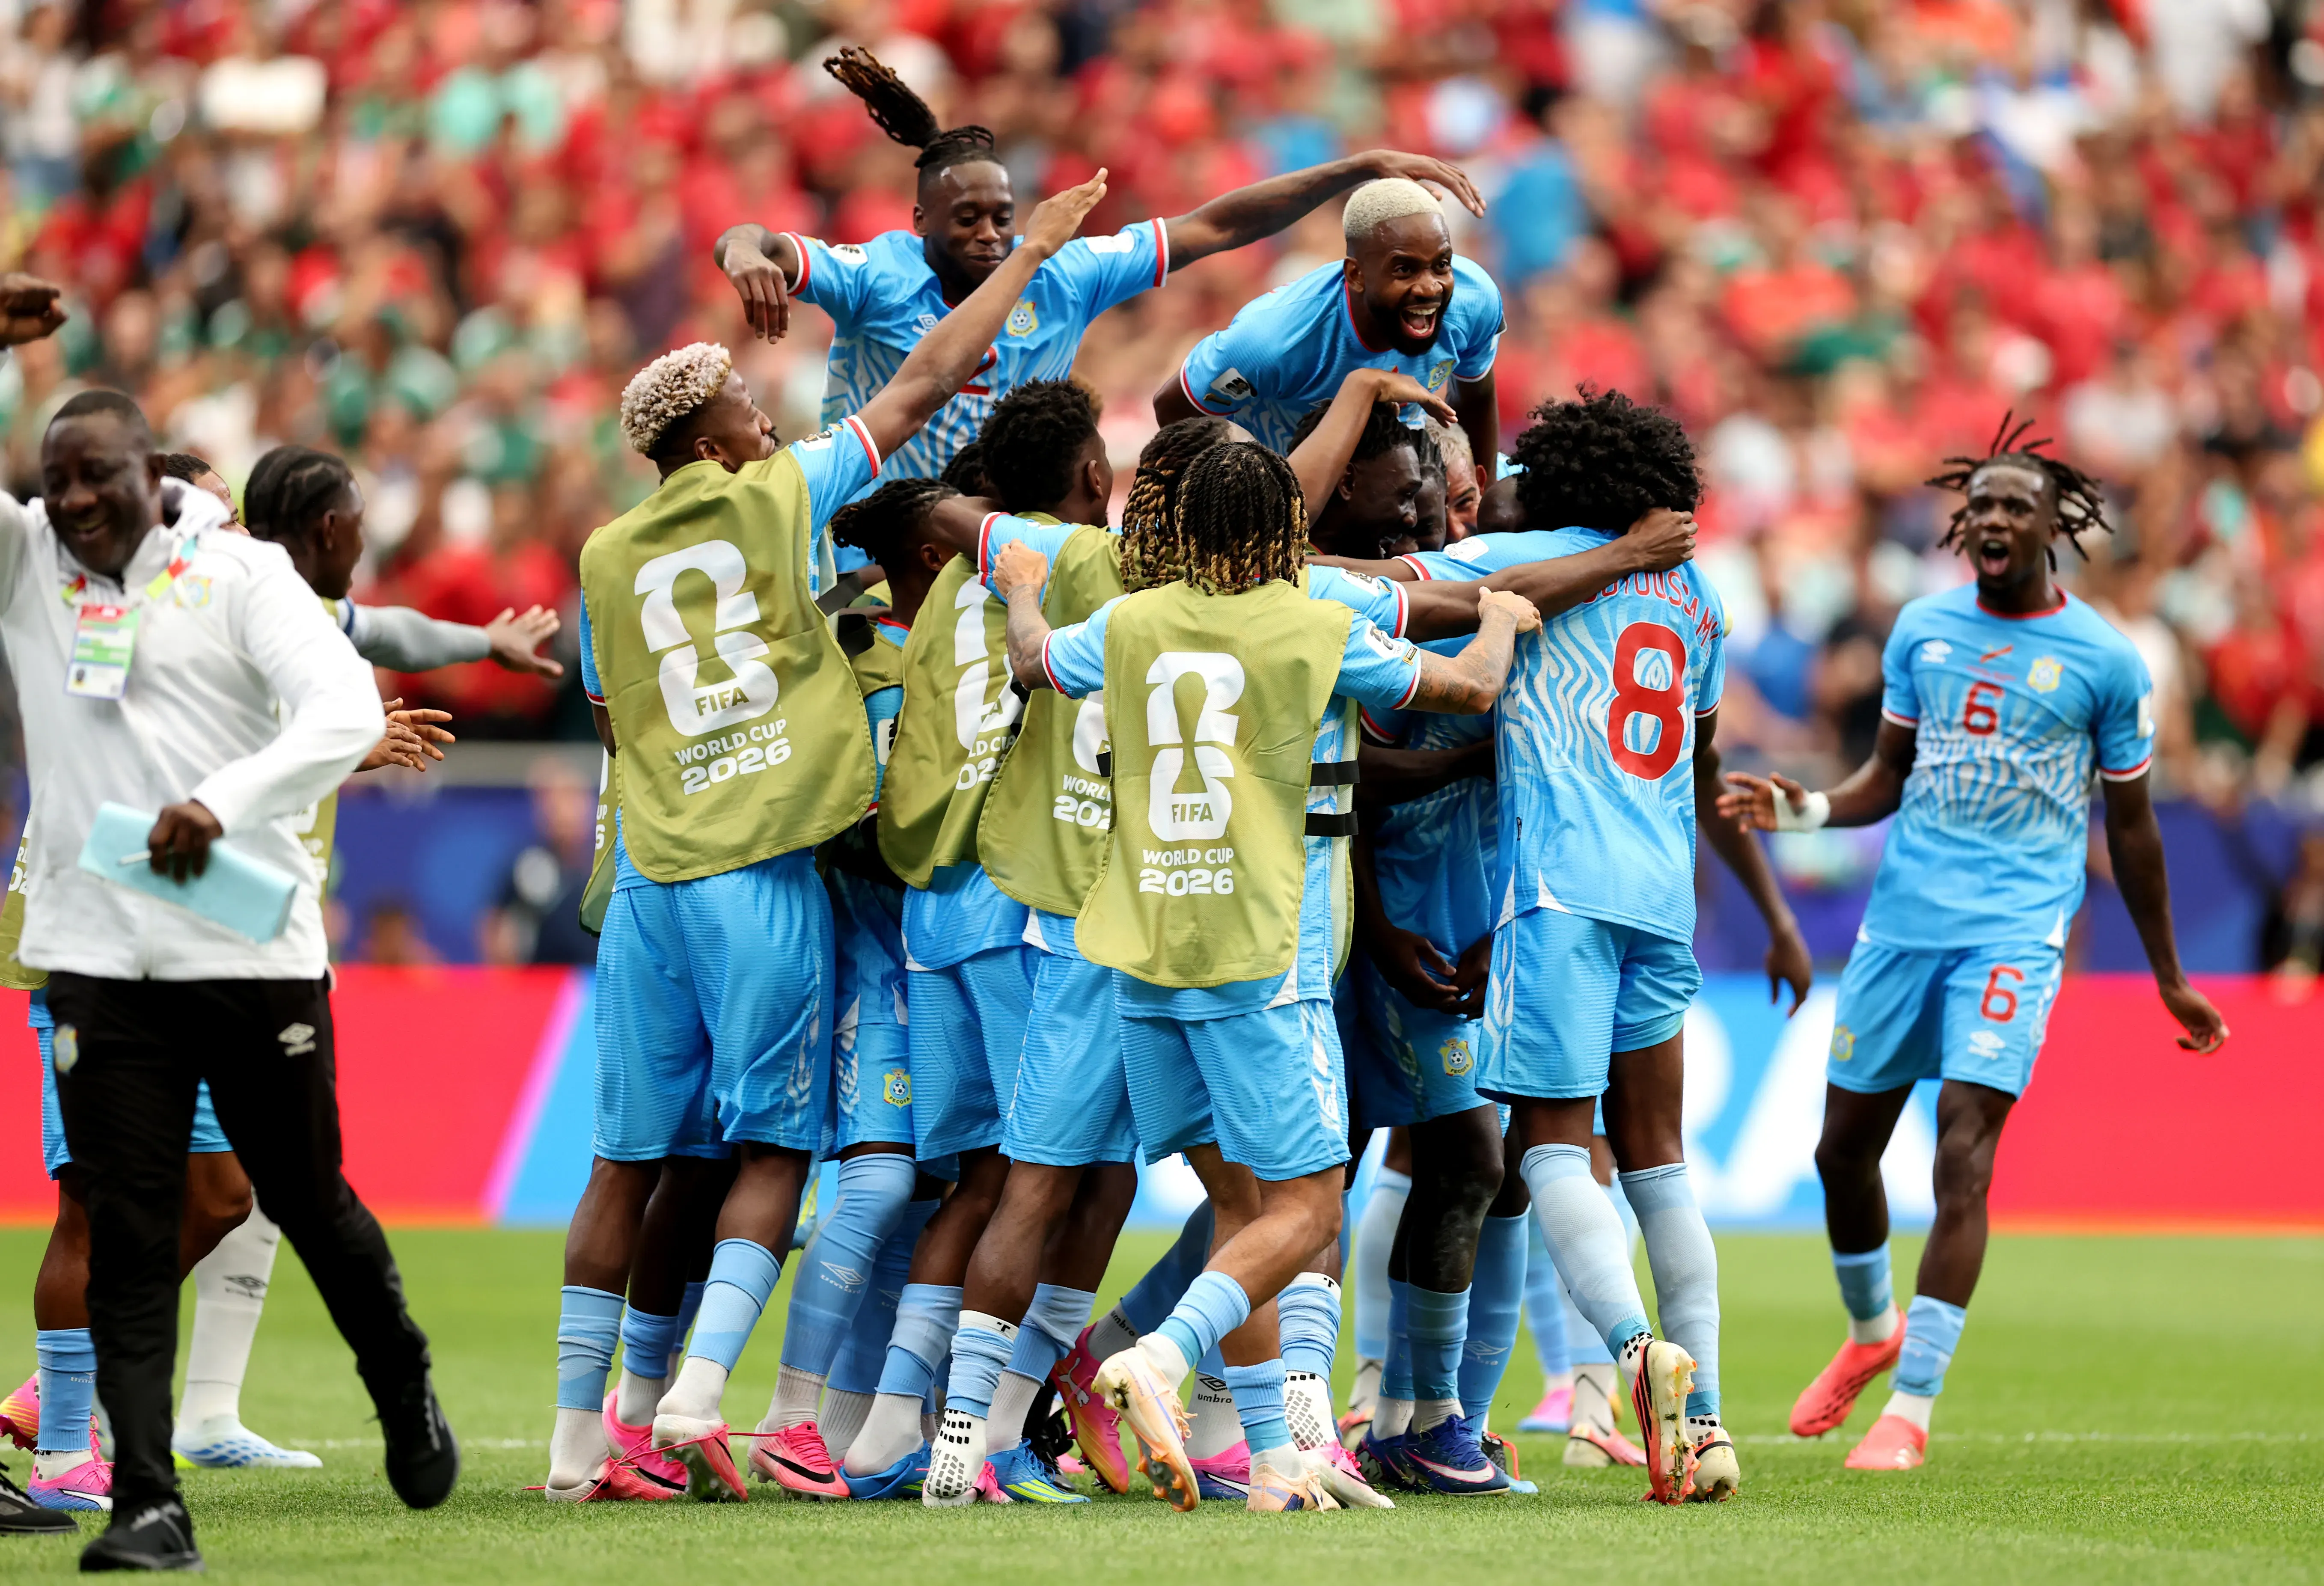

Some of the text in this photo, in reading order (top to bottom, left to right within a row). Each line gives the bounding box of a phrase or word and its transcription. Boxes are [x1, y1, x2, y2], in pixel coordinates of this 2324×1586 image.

[695, 687, 750, 716] FIFA
[1607, 621, 1687, 780] 8
[1964, 681, 2004, 736] 6
[675, 719, 787, 766] WORLD CUP
[681, 737, 792, 796] 2026
[1063, 774, 1111, 802] WORL
[596, 804, 608, 820] UP
[1053, 795, 1111, 830] 202
[1171, 803, 1213, 823] FIFA
[1142, 847, 1234, 867] WORLD CUP
[1139, 868, 1234, 897] 2026
[1981, 964, 2025, 1023] 6
[889, 1096, 911, 1104] FECOFA
[1110, 1310, 1135, 1336] umbro
[1198, 1393, 1232, 1403] umbro
